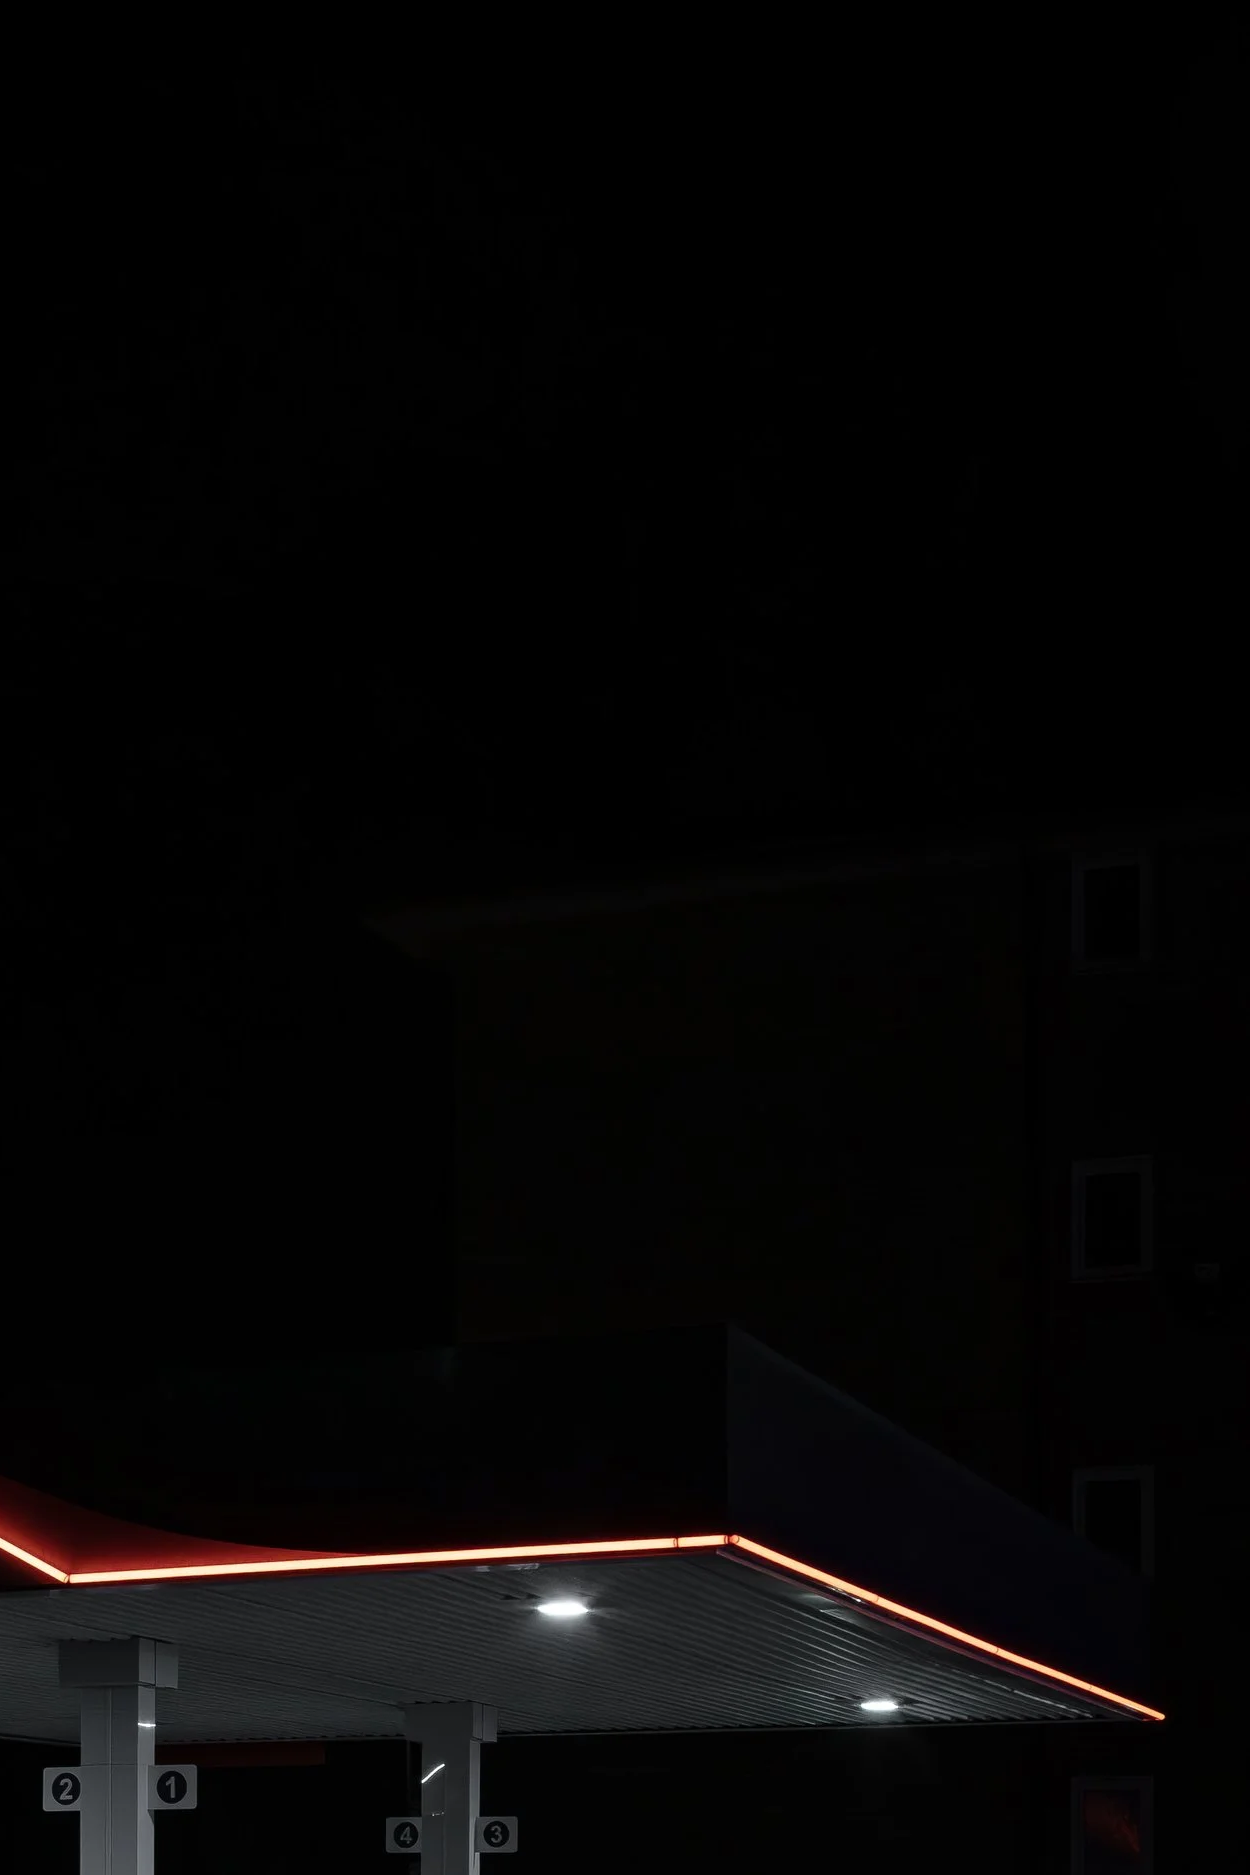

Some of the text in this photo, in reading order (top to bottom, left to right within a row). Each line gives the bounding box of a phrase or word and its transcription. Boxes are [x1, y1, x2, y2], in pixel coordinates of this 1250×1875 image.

[58, 1777, 73, 1801] 2
[165, 1775, 176, 1799] 1
[399, 1825, 413, 1845] 4
[490, 1824, 503, 1844] 3
